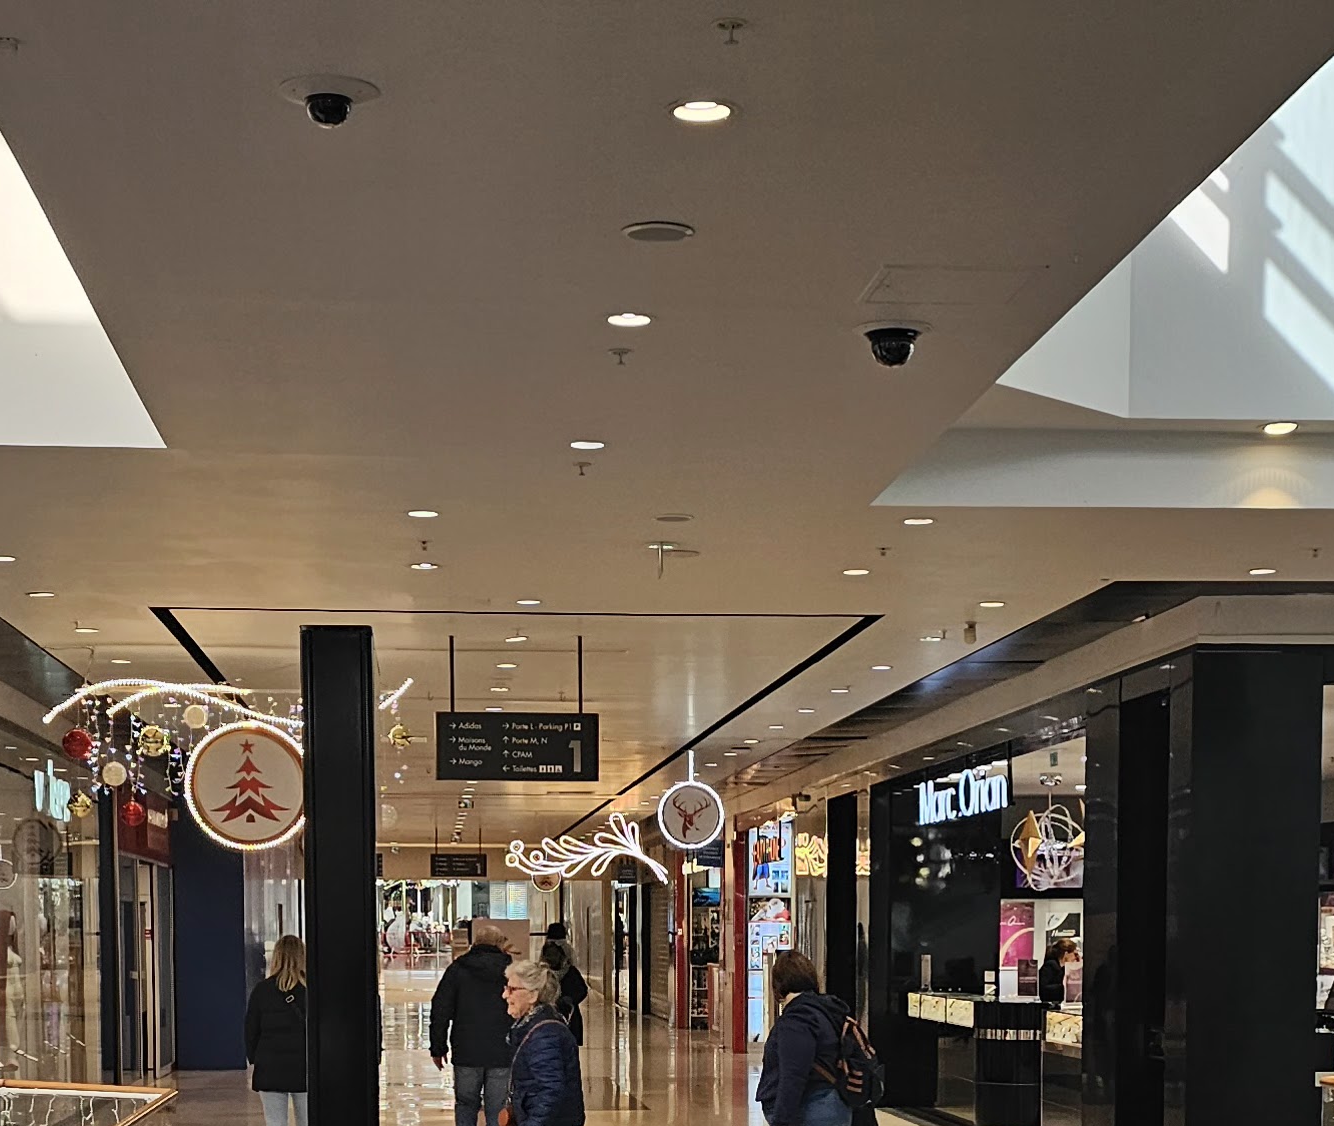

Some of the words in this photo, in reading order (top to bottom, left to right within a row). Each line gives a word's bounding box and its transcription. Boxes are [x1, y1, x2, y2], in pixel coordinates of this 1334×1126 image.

[458, 722, 482, 730] Adidas
[511, 722, 529, 730] Porte
[538, 722, 563, 732] Parking
[469, 743, 492, 751] Monde
[568, 740, 582, 773] 1
[458, 758, 483, 767] Mango
[512, 765, 537, 773] Toilettes
